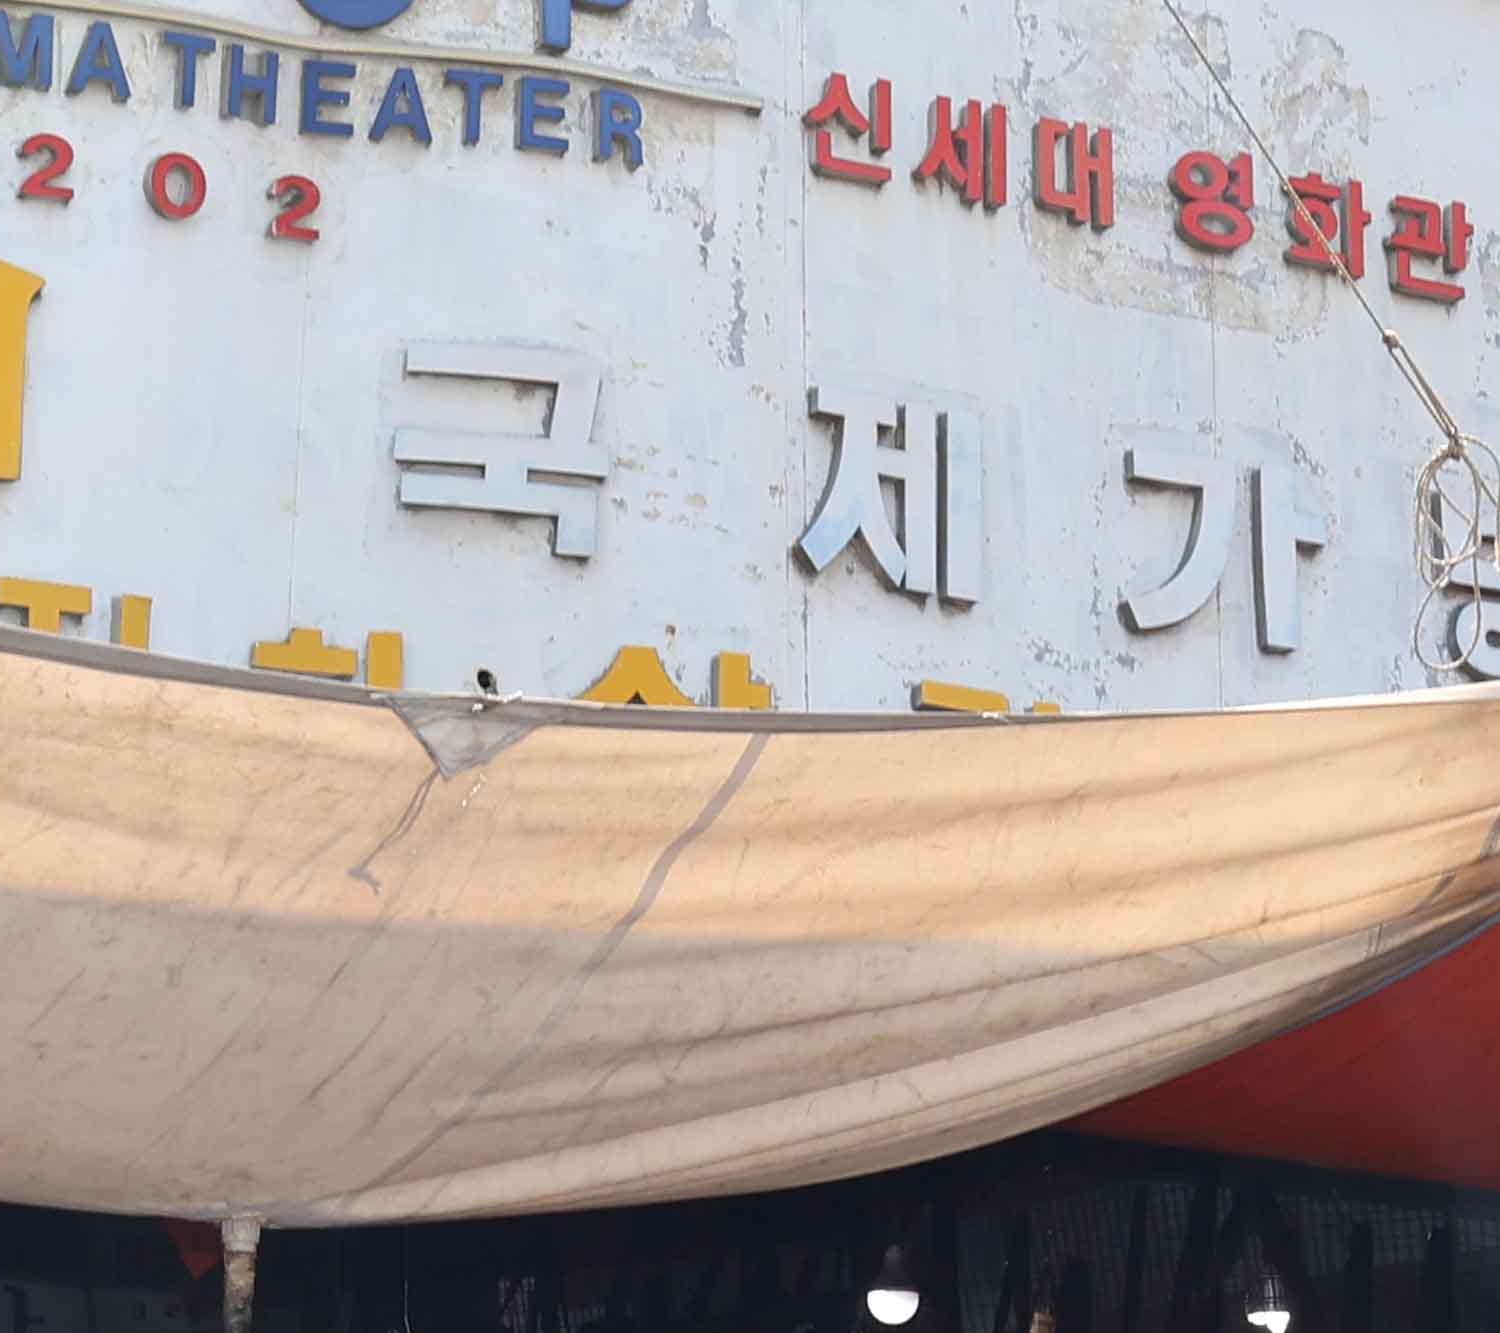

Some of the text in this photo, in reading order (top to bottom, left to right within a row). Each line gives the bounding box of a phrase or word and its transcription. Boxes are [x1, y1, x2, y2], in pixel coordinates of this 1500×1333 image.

[162, 26, 644, 171] THEATER
[803, 71, 1474, 304] 신세대 영화관
